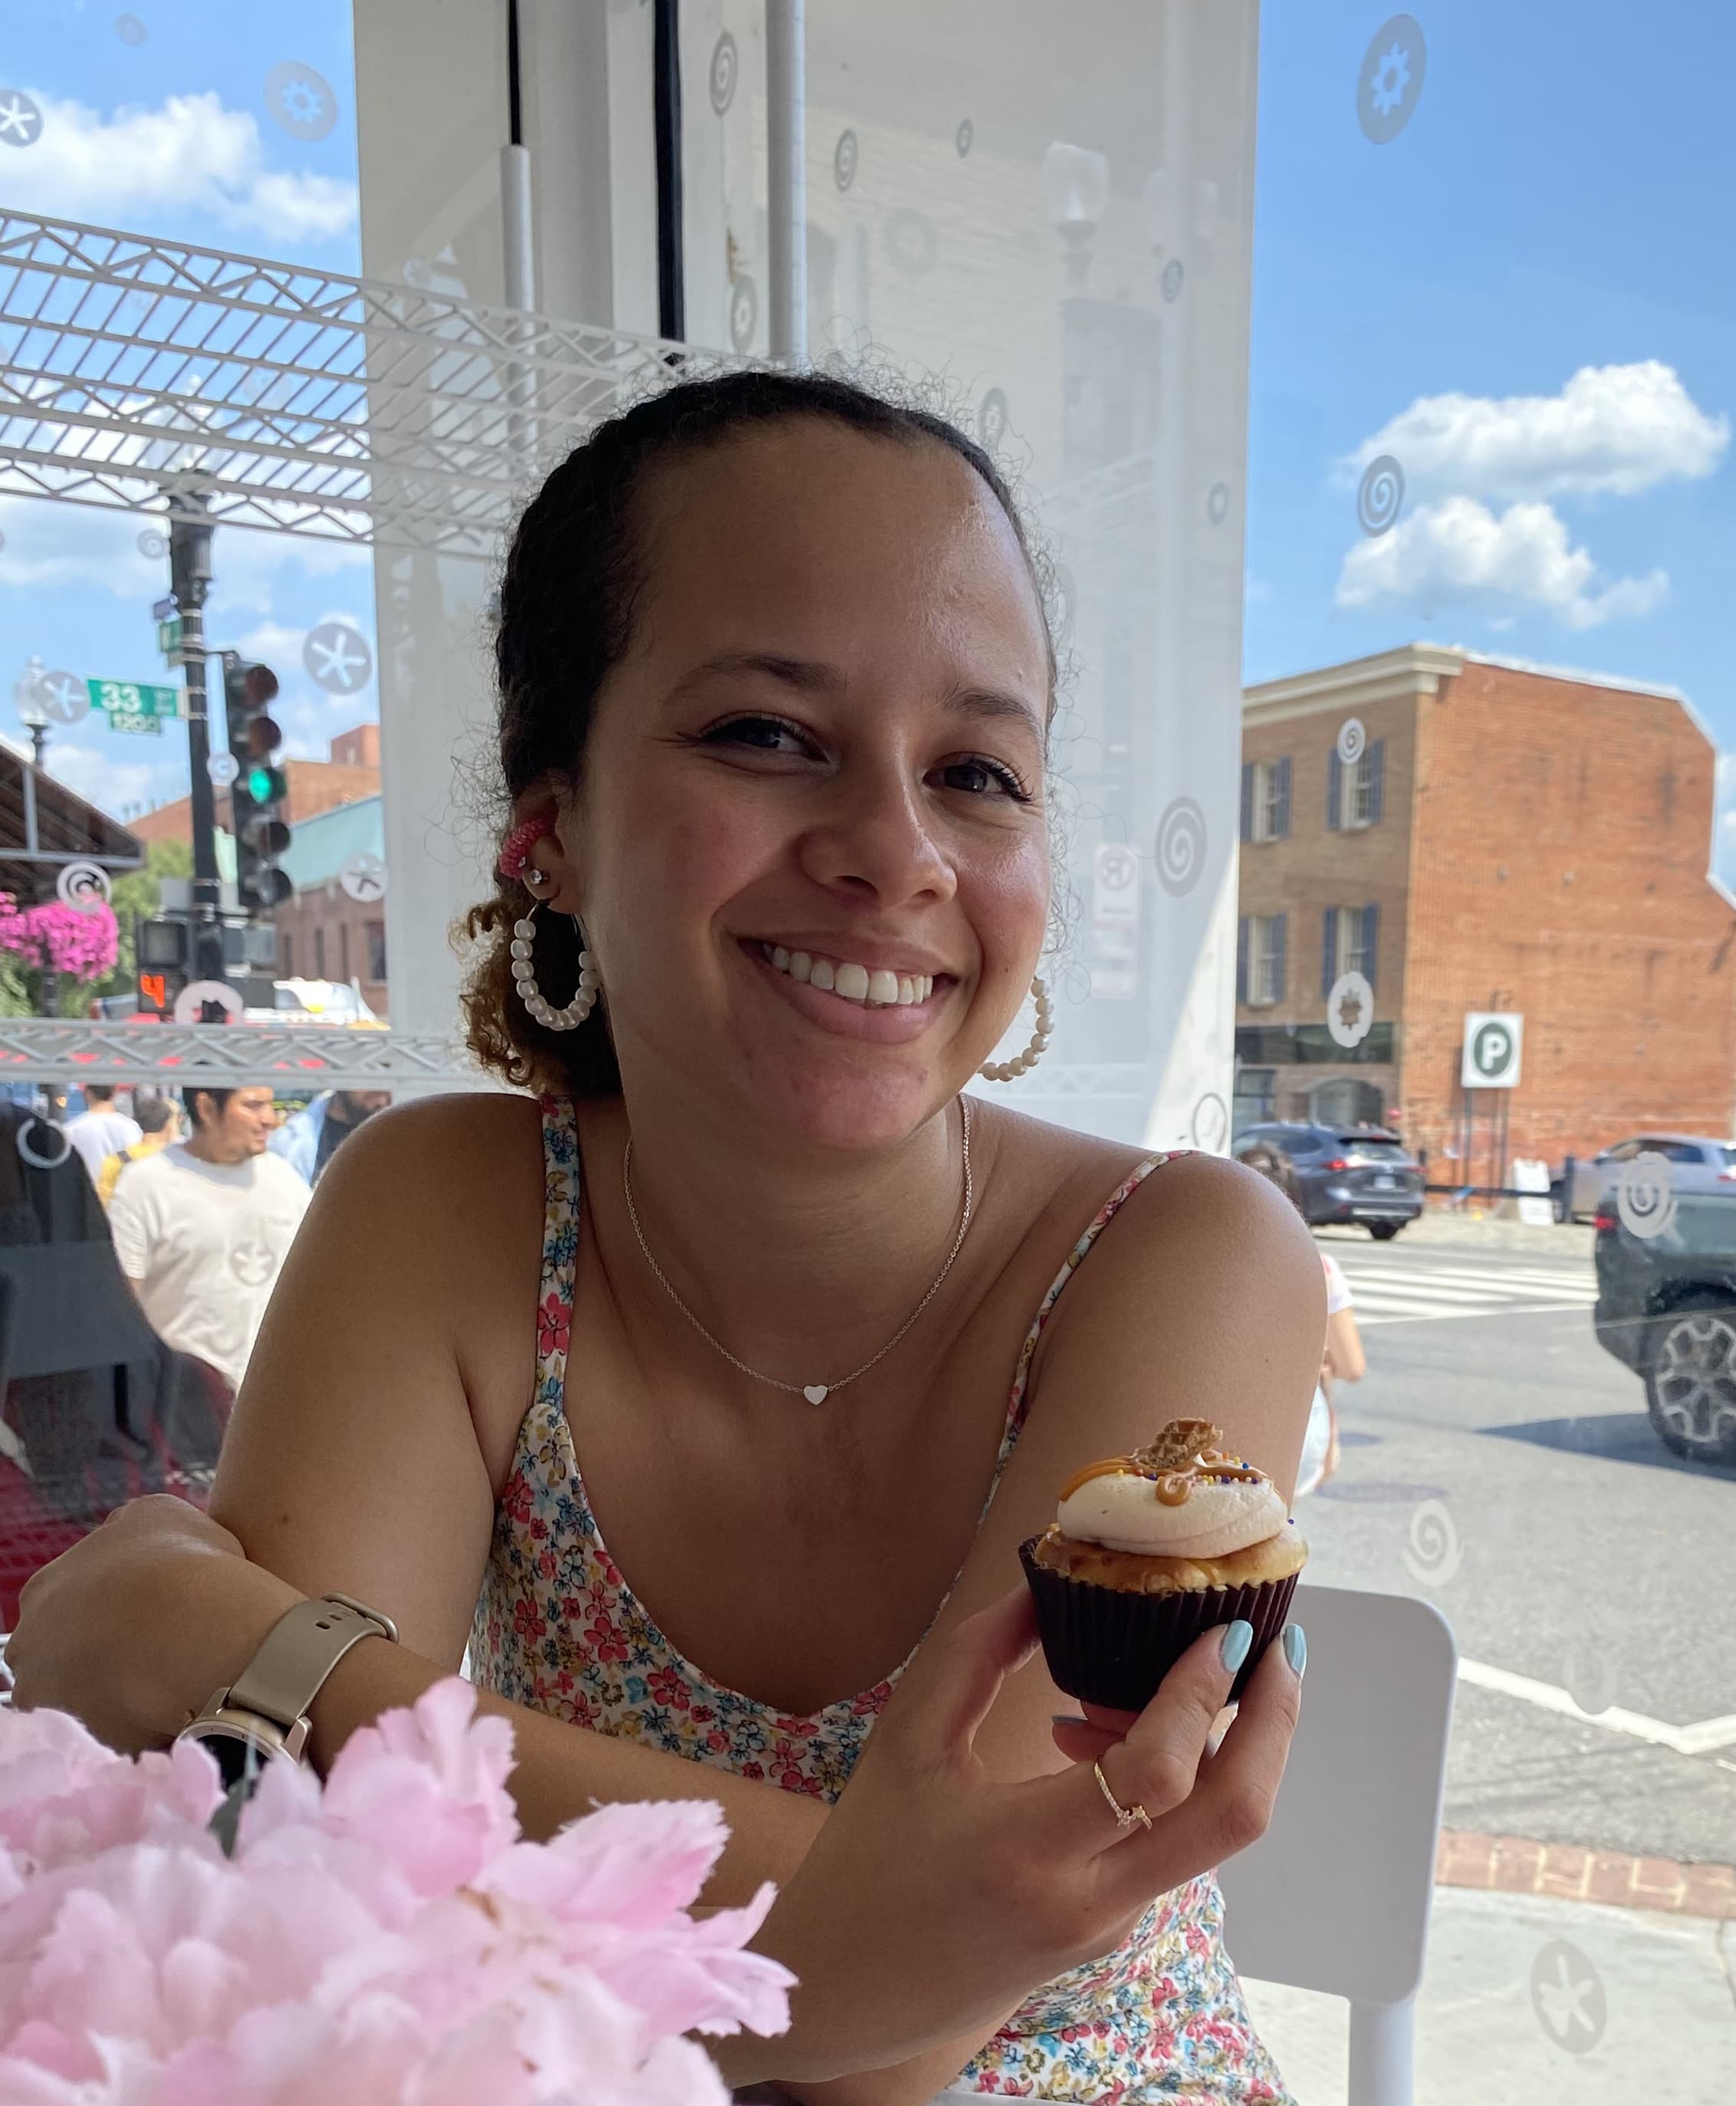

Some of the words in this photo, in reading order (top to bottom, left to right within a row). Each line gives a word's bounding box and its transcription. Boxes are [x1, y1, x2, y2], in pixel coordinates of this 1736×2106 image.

[101, 683, 141, 712] 33
[141, 974, 166, 1008] 4
[1482, 1032, 1507, 1069] P
